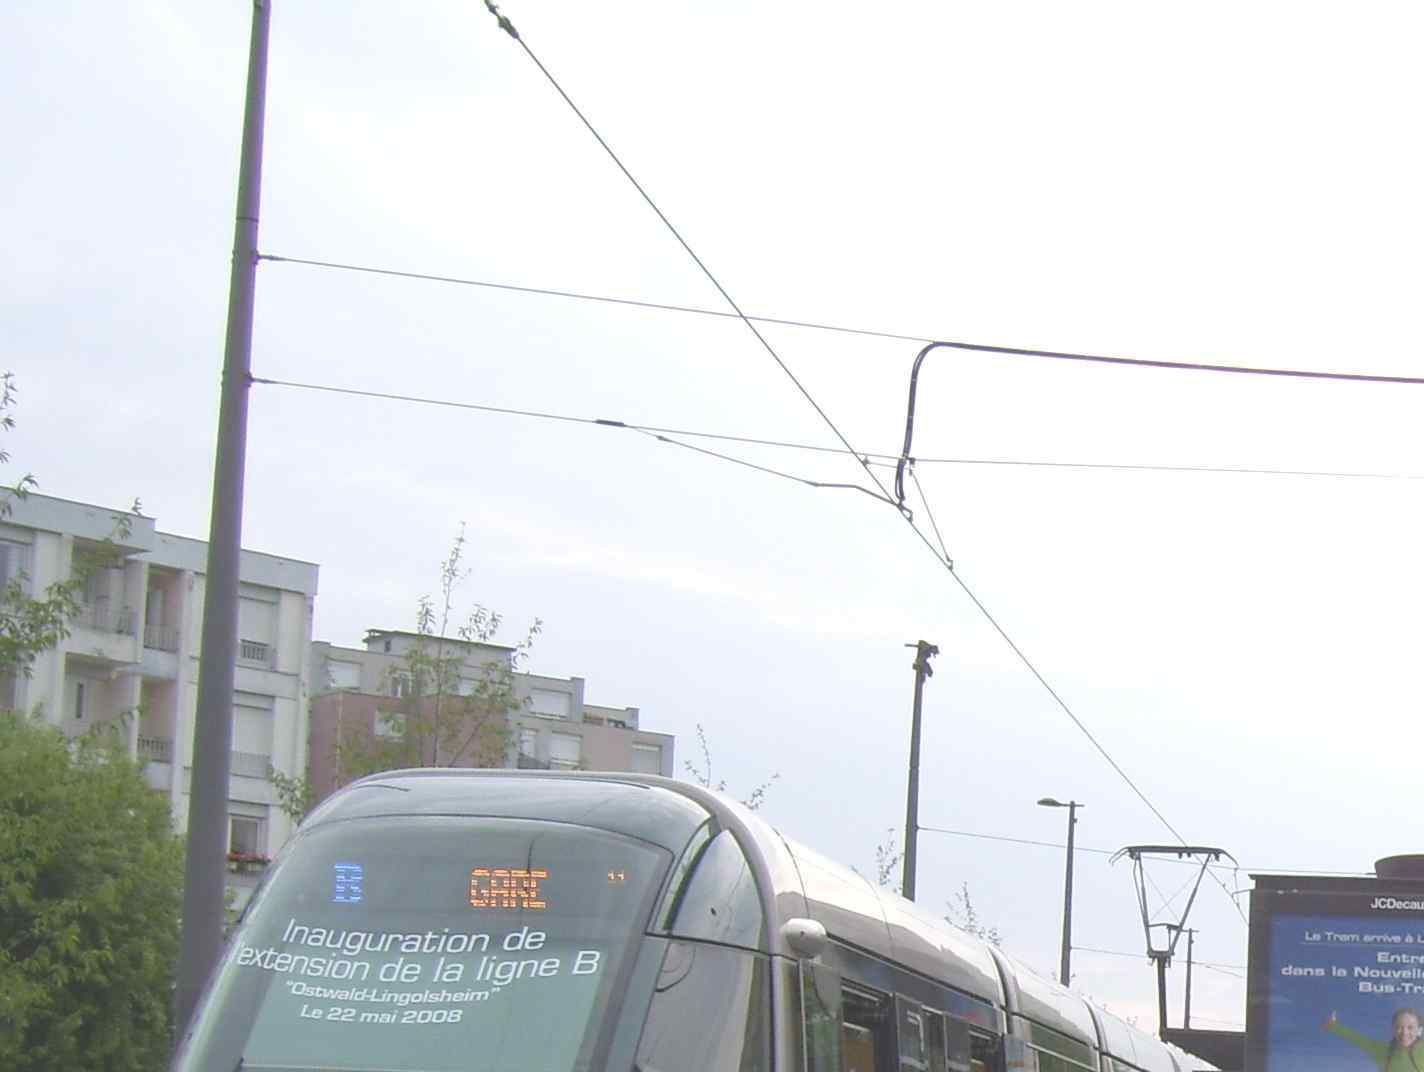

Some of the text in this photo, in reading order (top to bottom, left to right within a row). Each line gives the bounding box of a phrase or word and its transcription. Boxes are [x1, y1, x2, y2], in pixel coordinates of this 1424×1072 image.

[470, 868, 547, 908] GARE
[282, 917, 546, 956] Inauguration de
[1305, 930, 1321, 942] Le
[1325, 931, 1360, 943] Tram
[1363, 933, 1402, 945] arrive
[379, 955, 423, 984] de
[433, 957, 464, 983] la
[477, 955, 559, 986] ligne
[571, 950, 600, 976] B
[1281, 964, 1326, 977] dans
[1331, 965, 1348, 977] la
[300, 1004, 463, 1025] Le 22 mai 2008
